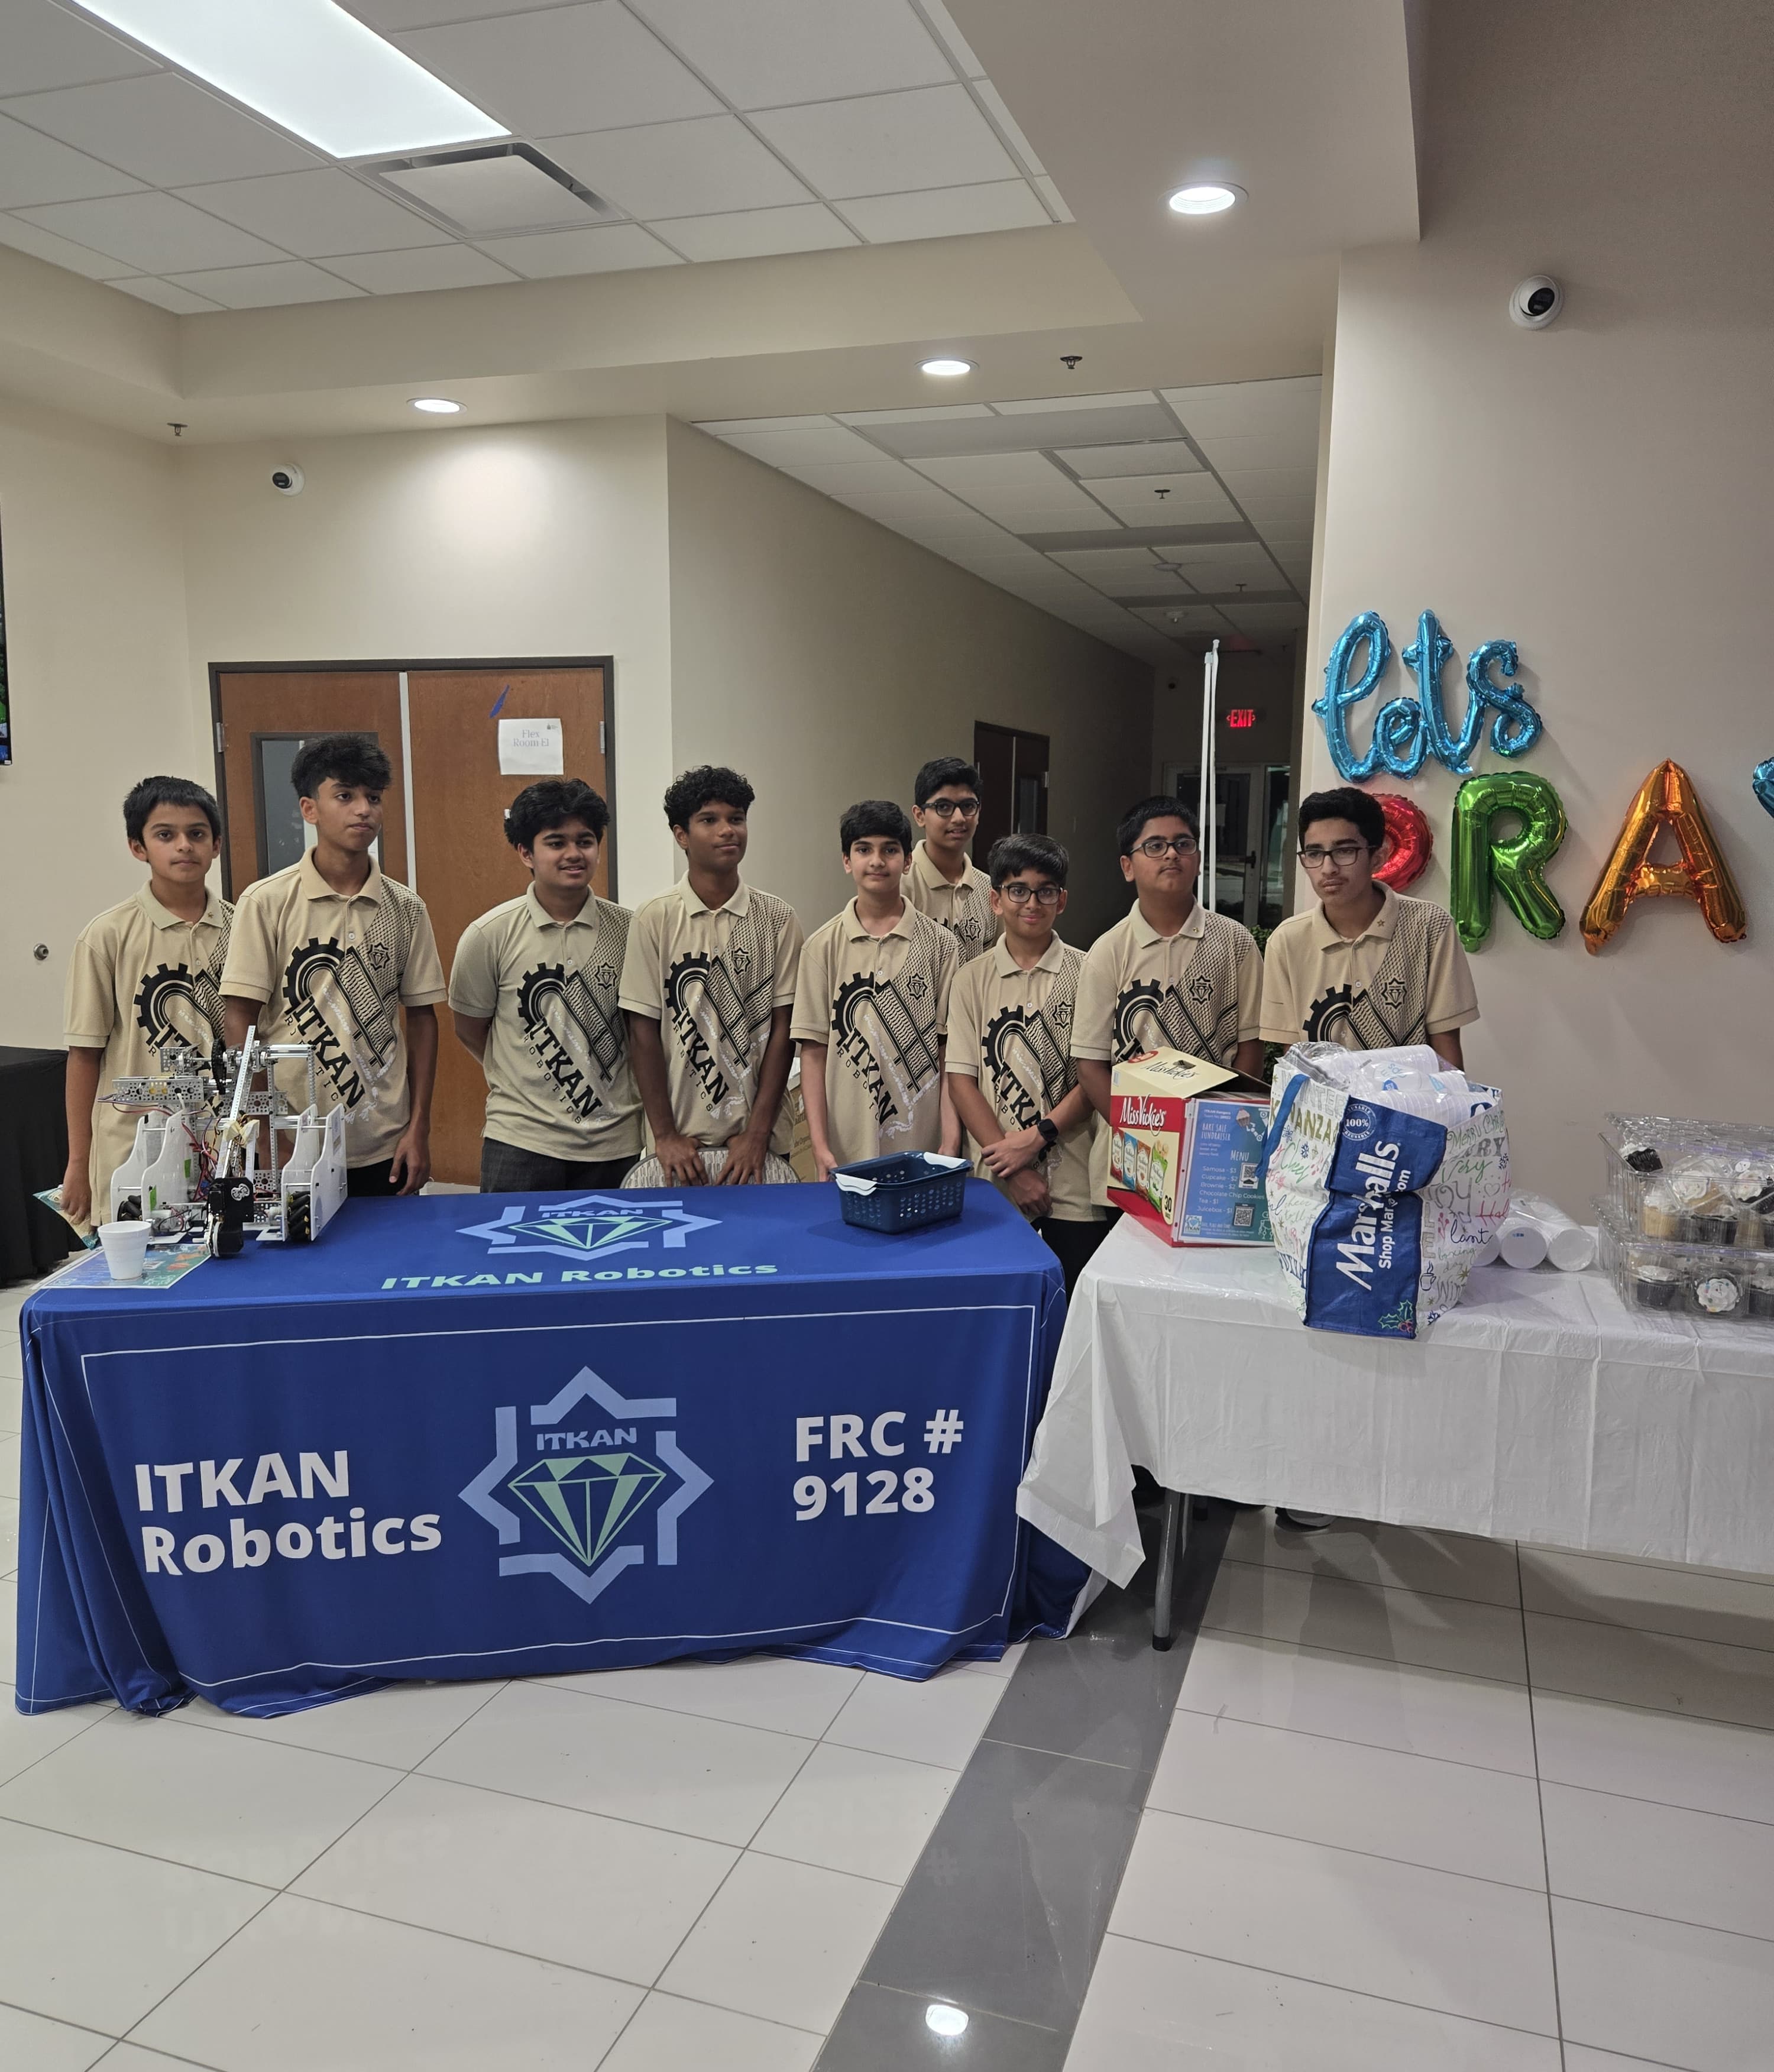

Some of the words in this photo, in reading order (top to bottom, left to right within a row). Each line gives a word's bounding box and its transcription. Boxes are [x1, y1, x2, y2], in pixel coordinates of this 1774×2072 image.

[1231, 709, 1253, 727] EXIT
[513, 738, 539, 747] Room
[522, 729, 540, 739] Flex
[293, 995, 366, 1109] ITKAN
[679, 1006, 730, 1106] ITKAN
[523, 1035, 582, 1124] ROBOTICS
[529, 1016, 603, 1118] ITKAN
[1202, 1122, 1215, 1131] BAKE
[1216, 1124, 1227, 1132] SALE
[1346, 1118, 1369, 1127] 100%
[1201, 1131, 1231, 1141] FUNDRAISER
[1230, 1150, 1249, 1161] MENU
[541, 1208, 643, 1218] ITKAN
[1164, 1195, 1173, 1212] 30
[1336, 1141, 1400, 1291] Marshalls
[1378, 1236, 1396, 1270] Shop
[1438, 1246, 1477, 1265] boxing
[381, 1271, 543, 1290] ITKAN
[560, 1263, 779, 1283] Robotics
[536, 1427, 638, 1451] ITKAN
[796, 1410, 907, 1462] FRC
[923, 1409, 964, 1454] #
[134, 1449, 349, 1513] ITKAN
[792, 1466, 935, 1521] 9128
[140, 1507, 442, 1576] Robotics
